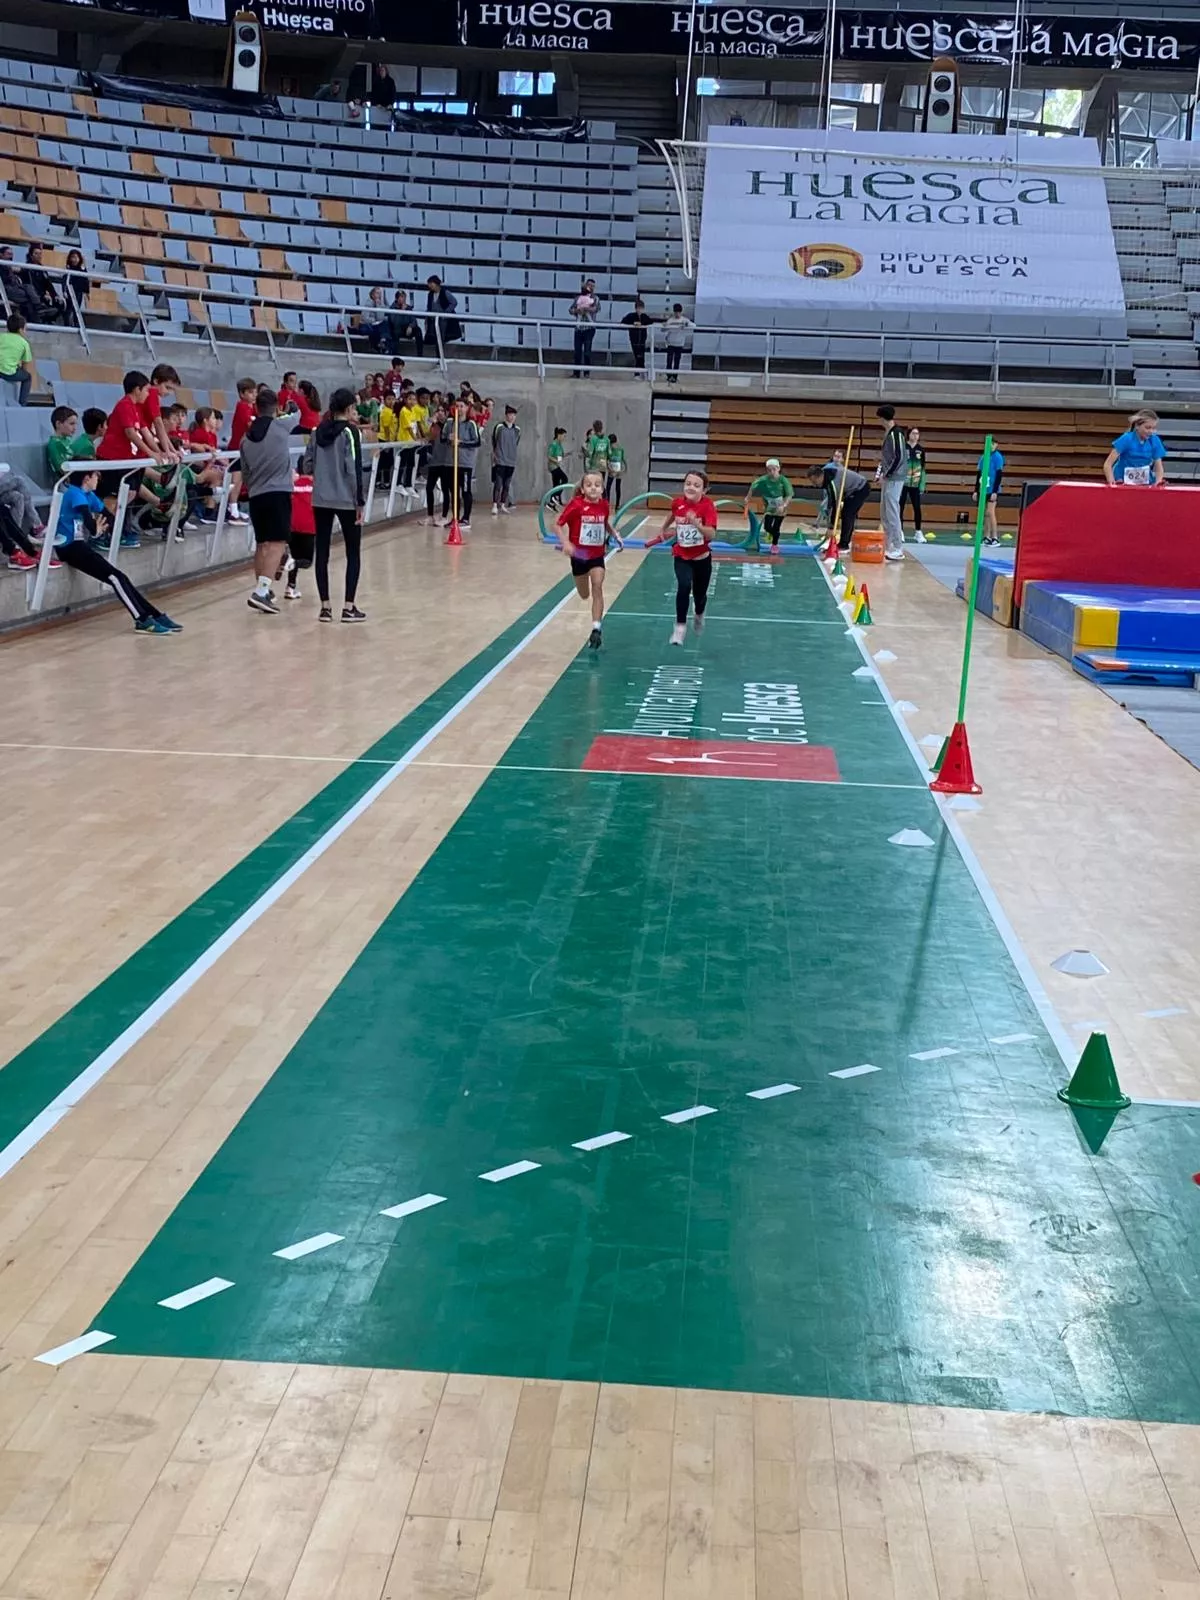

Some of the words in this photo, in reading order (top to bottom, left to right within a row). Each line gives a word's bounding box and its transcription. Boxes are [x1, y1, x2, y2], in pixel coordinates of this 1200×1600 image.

[263, 7, 334, 32] Huesca
[479, 2, 613, 31] Huesca
[671, 9, 806, 37] Huesca
[850, 22, 999, 54] Huesca
[746, 169, 1066, 205] Huesca
[880, 252, 1028, 266] DIPUTACIÓN
[880, 264, 1028, 278] HUESCA
[1127, 471, 1146, 480] 624
[679, 530, 699, 541] 422
